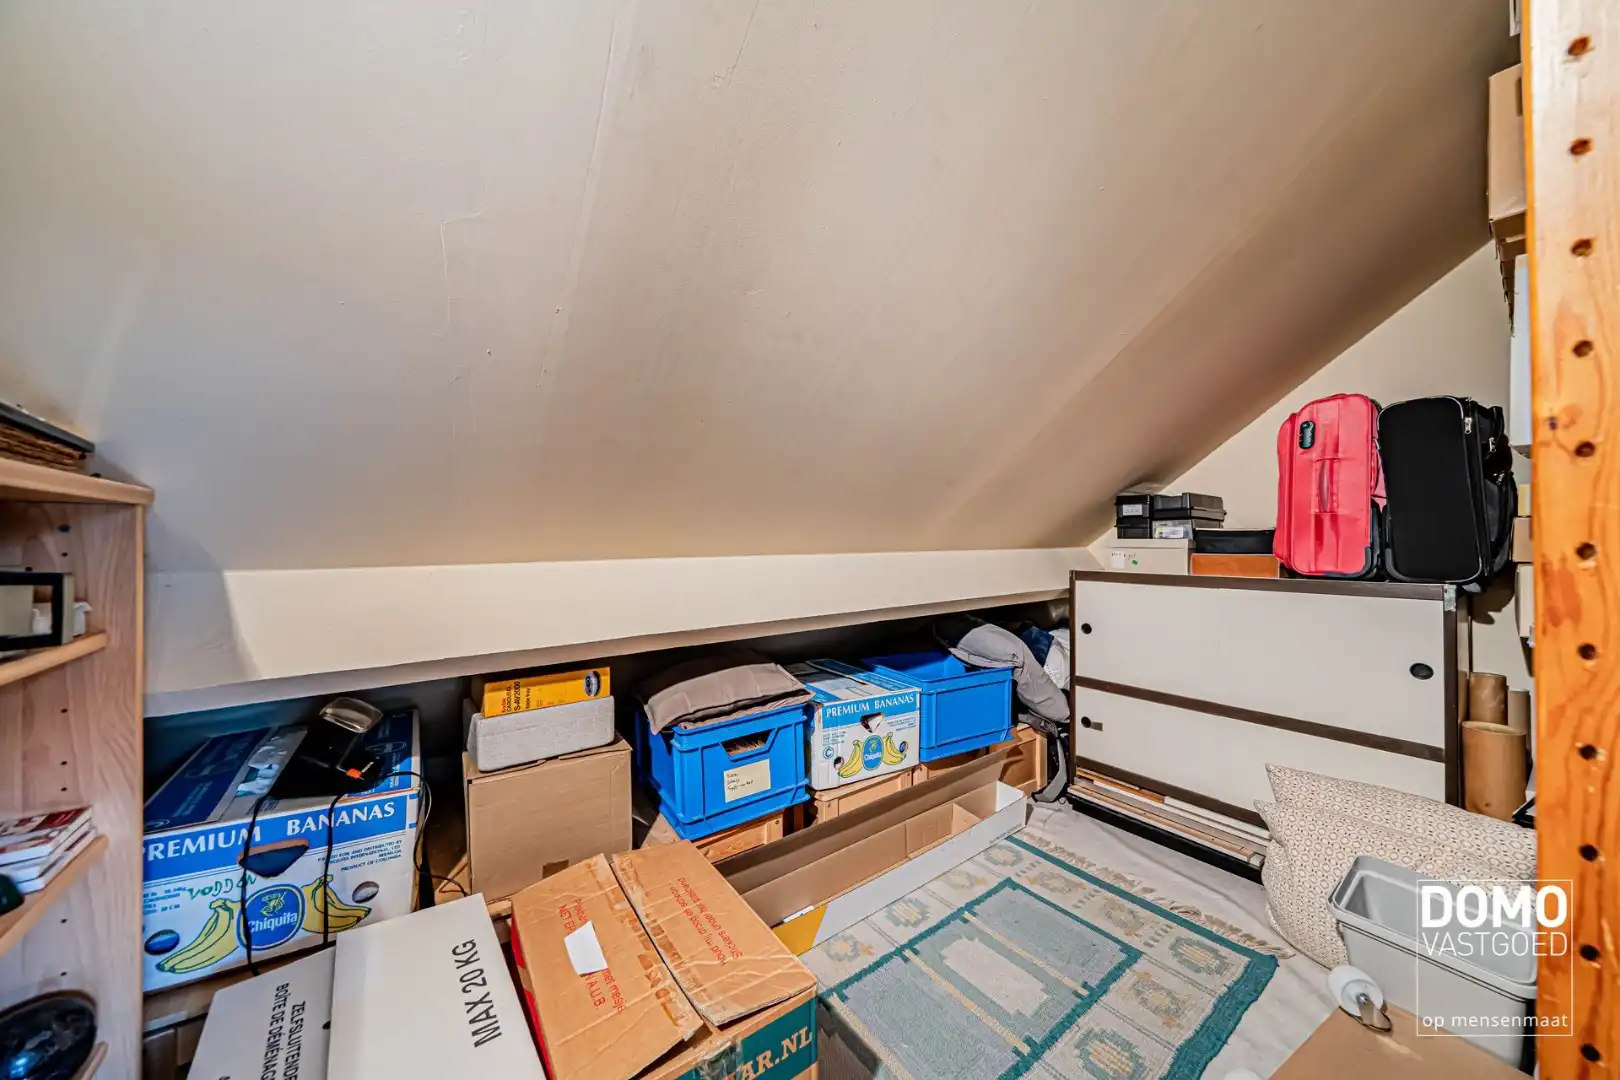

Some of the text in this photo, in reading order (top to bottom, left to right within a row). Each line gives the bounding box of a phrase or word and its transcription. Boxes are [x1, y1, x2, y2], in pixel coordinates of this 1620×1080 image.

[826, 694, 914, 718] PREMIUM BANANAS
[142, 801, 395, 861] REMIUM BANANAS
[451, 939, 502, 1048] MAX 20 KG
[270, 1010, 285, 1027] DE
